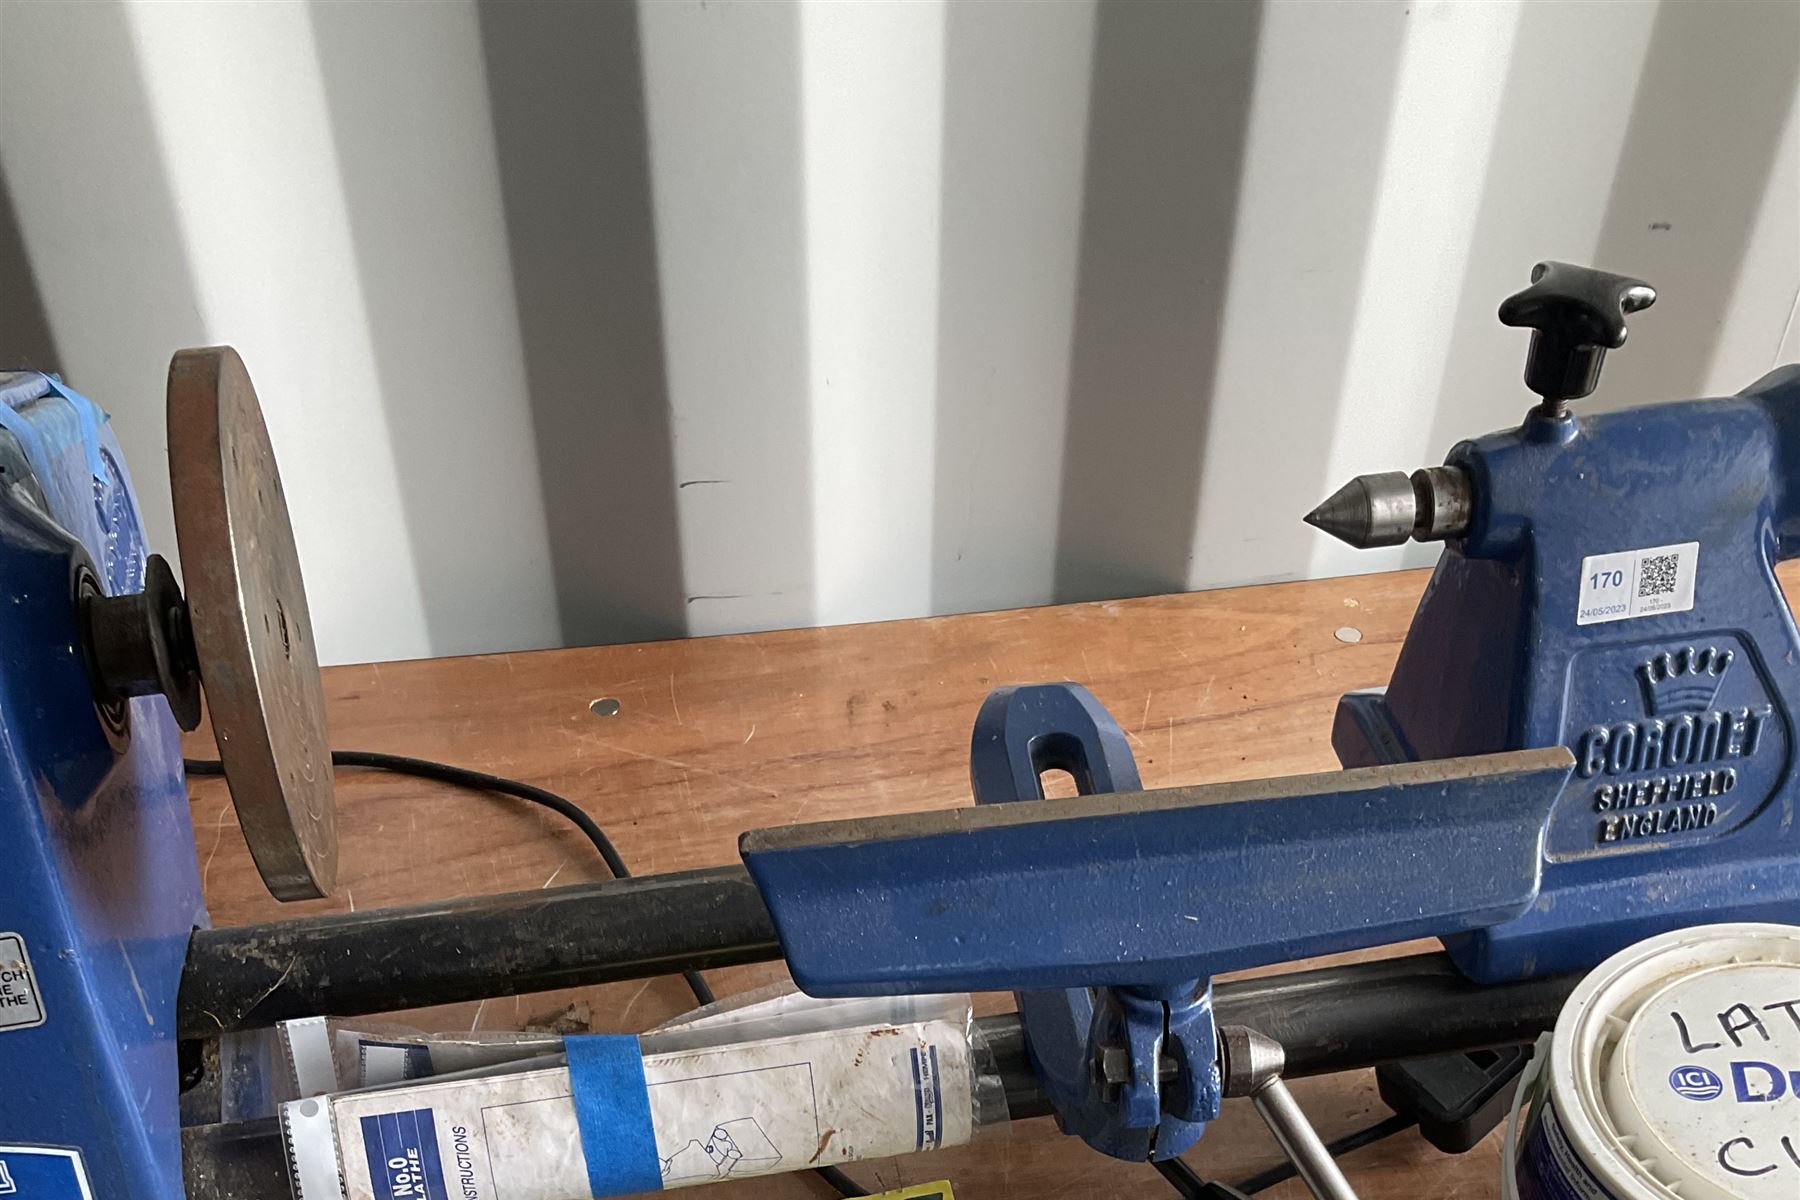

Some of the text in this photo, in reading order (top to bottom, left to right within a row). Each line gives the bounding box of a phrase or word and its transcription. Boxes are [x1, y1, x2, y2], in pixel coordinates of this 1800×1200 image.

[1590, 570, 1623, 590] 170
[1580, 604, 1627, 618] 24/05/2023
[1577, 704, 1772, 779] CORONET
[1594, 768, 1737, 813] SHEFFIELD
[1598, 802, 1718, 843] ENGLAND
[1671, 998, 1800, 1053] LAT
[1677, 1070, 1712, 1089] ICI
[388, 1157, 414, 1197] No.0
[1583, 1178, 1598, 1196] and
